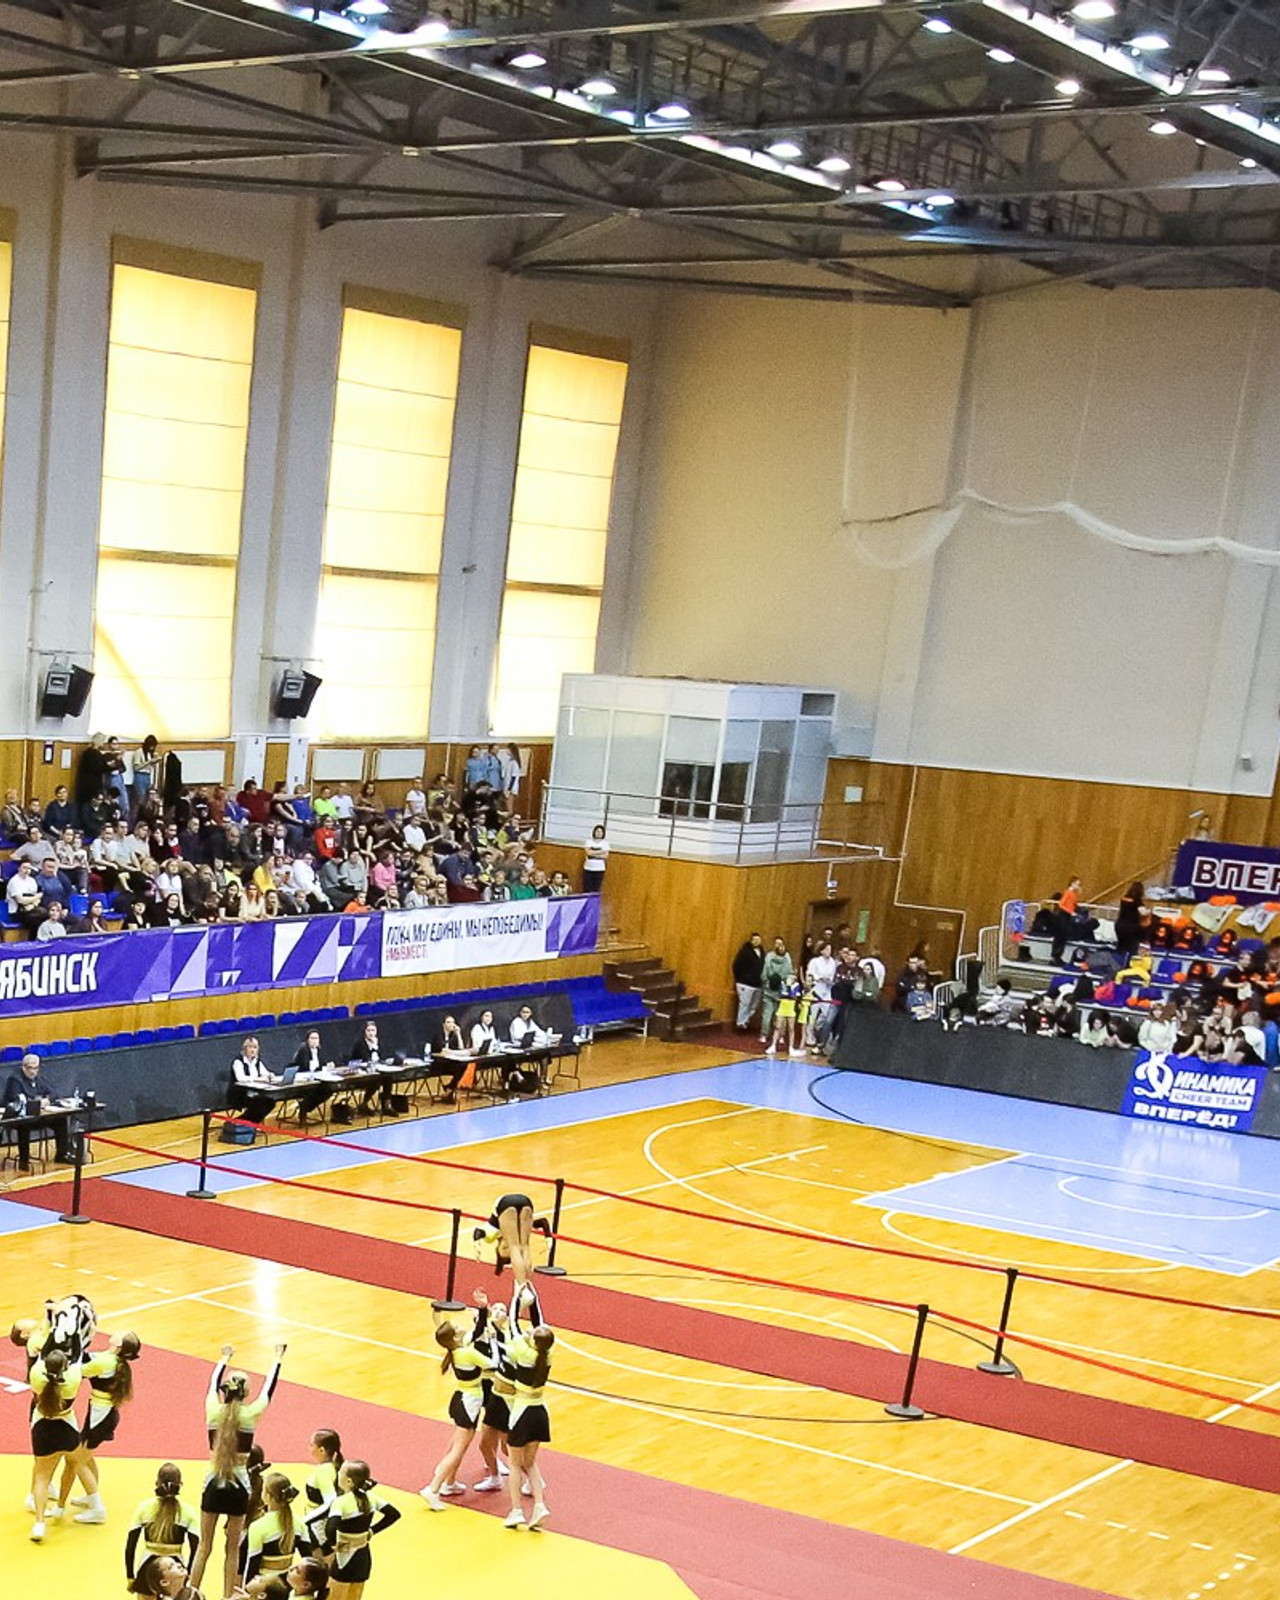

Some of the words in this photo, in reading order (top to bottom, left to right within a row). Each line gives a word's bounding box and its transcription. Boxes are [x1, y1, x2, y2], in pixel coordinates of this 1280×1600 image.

[465, 919, 482, 938] МЫ
[1174, 1092, 1211, 1105] CHEER
[1216, 1097, 1248, 1107] TEAM
[1133, 1102, 1238, 1129] ВПЕРЁД!
